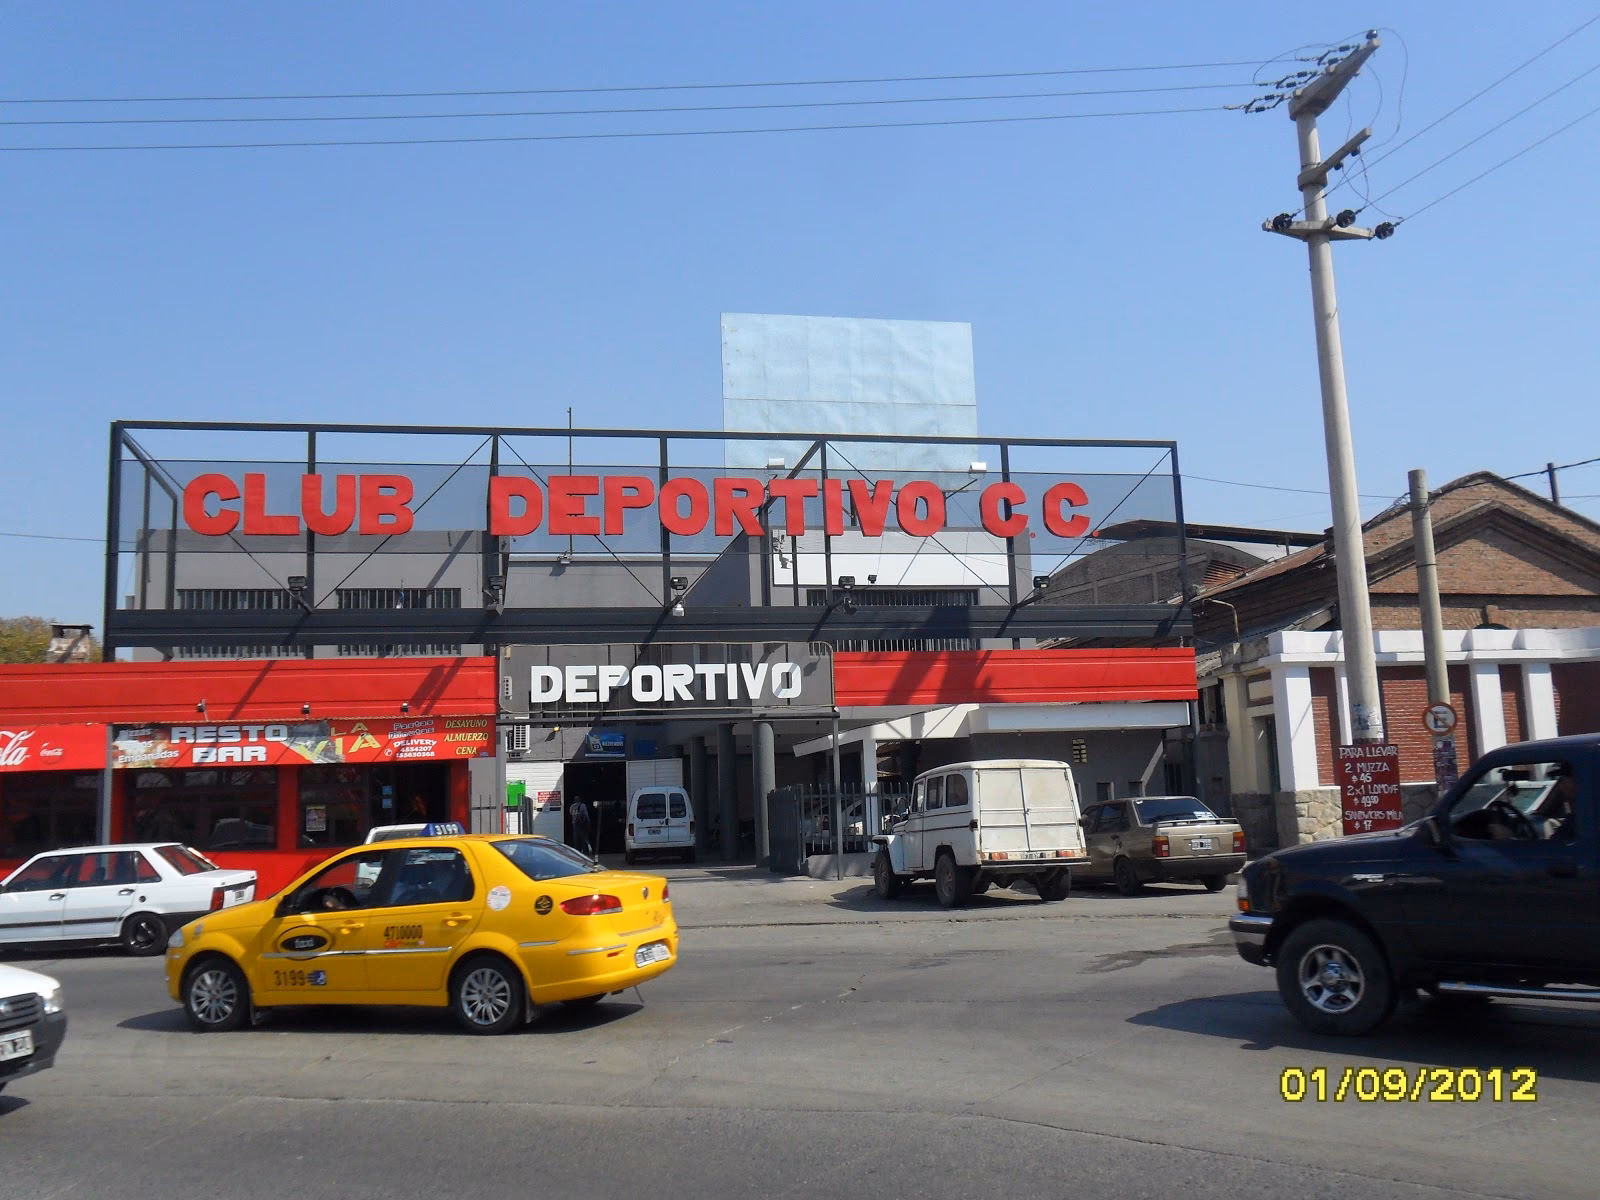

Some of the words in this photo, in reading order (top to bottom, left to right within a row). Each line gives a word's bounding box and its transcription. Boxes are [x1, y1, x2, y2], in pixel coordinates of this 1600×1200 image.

[183, 473, 415, 536] CLUB
[490, 475, 947, 538] DEPORTIVO
[531, 662, 802, 703] DEPORTIVO
[330, 722, 368, 736] LA
[445, 719, 488, 729] DESAYUNO
[170, 724, 288, 744] RESTO
[443, 731, 489, 742] ALMUERZO
[393, 738, 437, 748] DELIVERY
[118, 749, 180, 763] Empanadas
[192, 746, 267, 763] BAR
[455, 746, 477, 755] CENA
[1339, 747, 1364, 759] PARA
[1366, 746, 1398, 757] LLEVAR
[1345, 762, 1353, 773] 2
[1357, 762, 1390, 773] MUZZA
[434, 823, 459, 835] 3199
[274, 970, 306, 987] 3199
